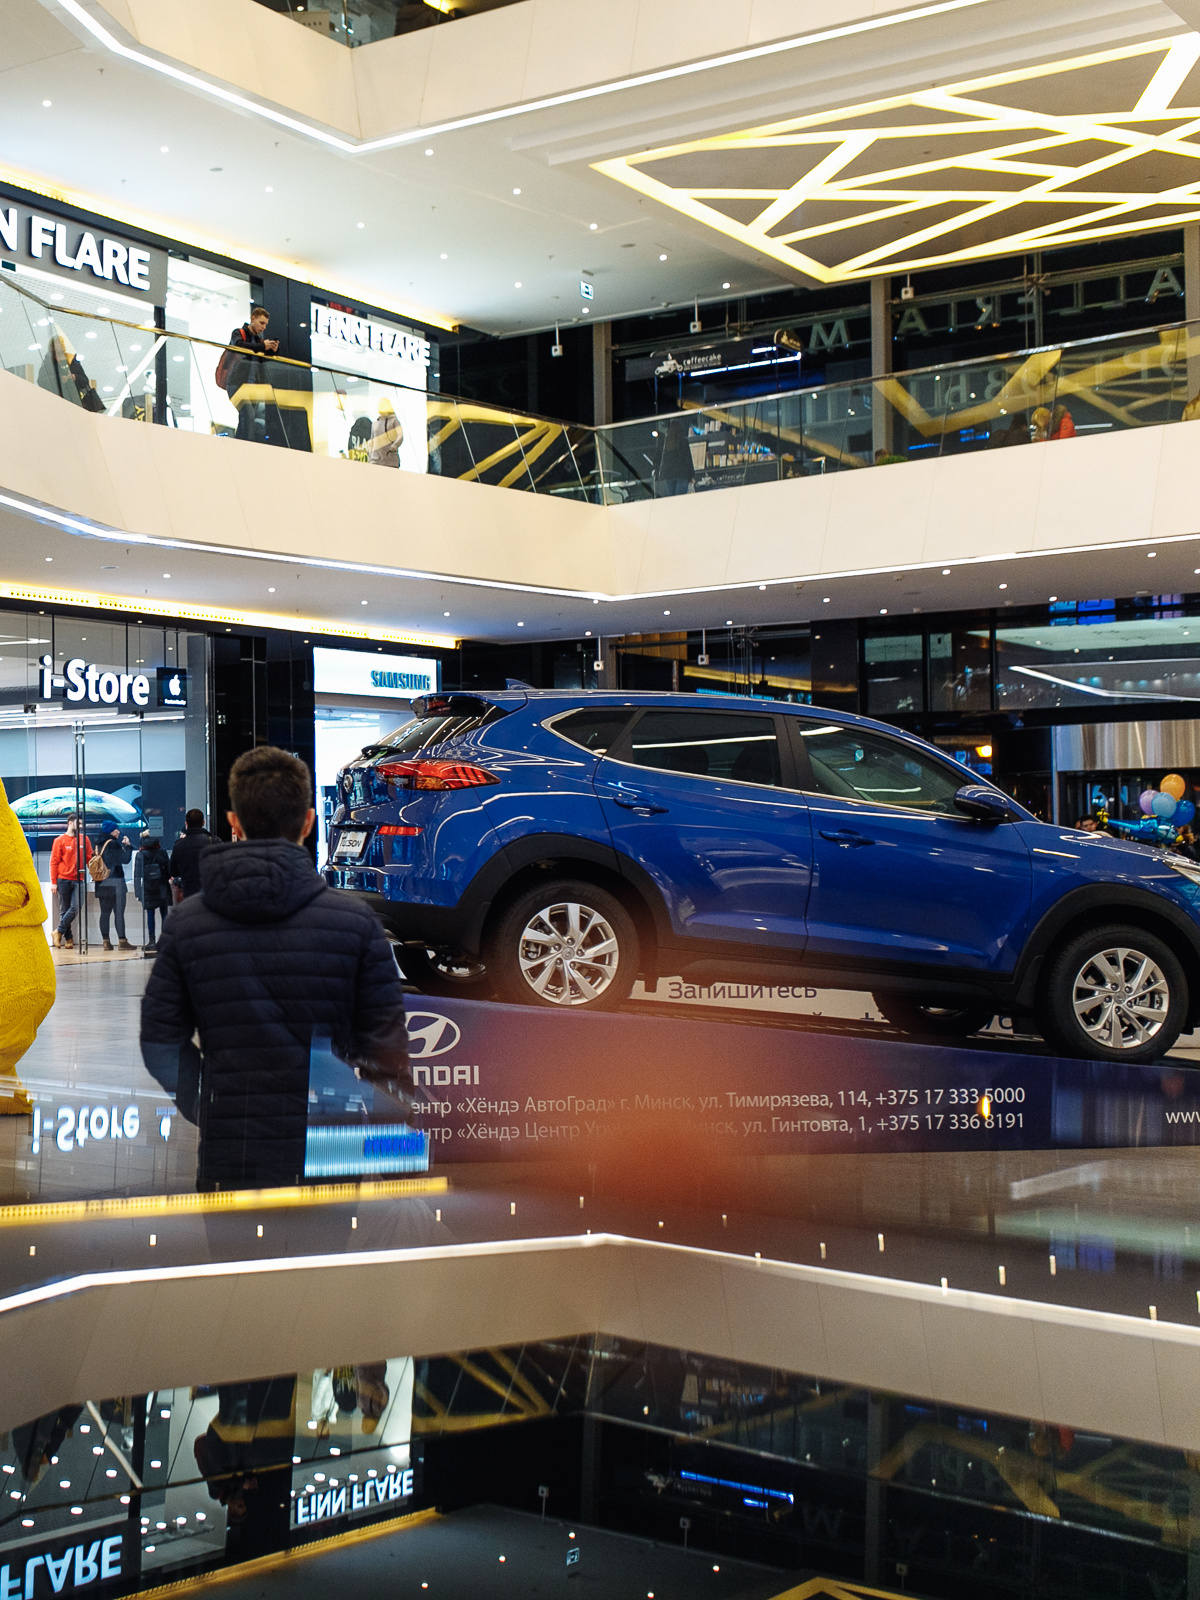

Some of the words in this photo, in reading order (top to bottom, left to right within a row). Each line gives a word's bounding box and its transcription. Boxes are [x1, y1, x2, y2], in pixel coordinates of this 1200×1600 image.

[30, 215, 151, 291] FLARE
[367, 322, 431, 367] FLARE
[41, 654, 150, 706] i-Store
[370, 669, 431, 691] SAMSUNG
[668, 981, 818, 1000] Запишитесь
[412, 1064, 481, 1087] NDAI
[700, 1096, 723, 1113] ул.
[725, 1091, 834, 1111] Тимирязева,
[837, 1090, 873, 1109] 114,
[875, 1088, 919, 1106] +375
[926, 1088, 944, 1105] 17
[949, 1087, 980, 1105] 333
[984, 1086, 1026, 1104] 5000
[524, 1121, 580, 1141] Центр
[743, 1121, 767, 1137] ул.
[771, 1117, 853, 1135] Гинтовта,
[858, 1117, 872, 1134] 1,
[876, 1114, 920, 1131] +375
[927, 1114, 945, 1130] 17
[949, 1112, 981, 1130] 336
[984, 1112, 1025, 1129] 8191
